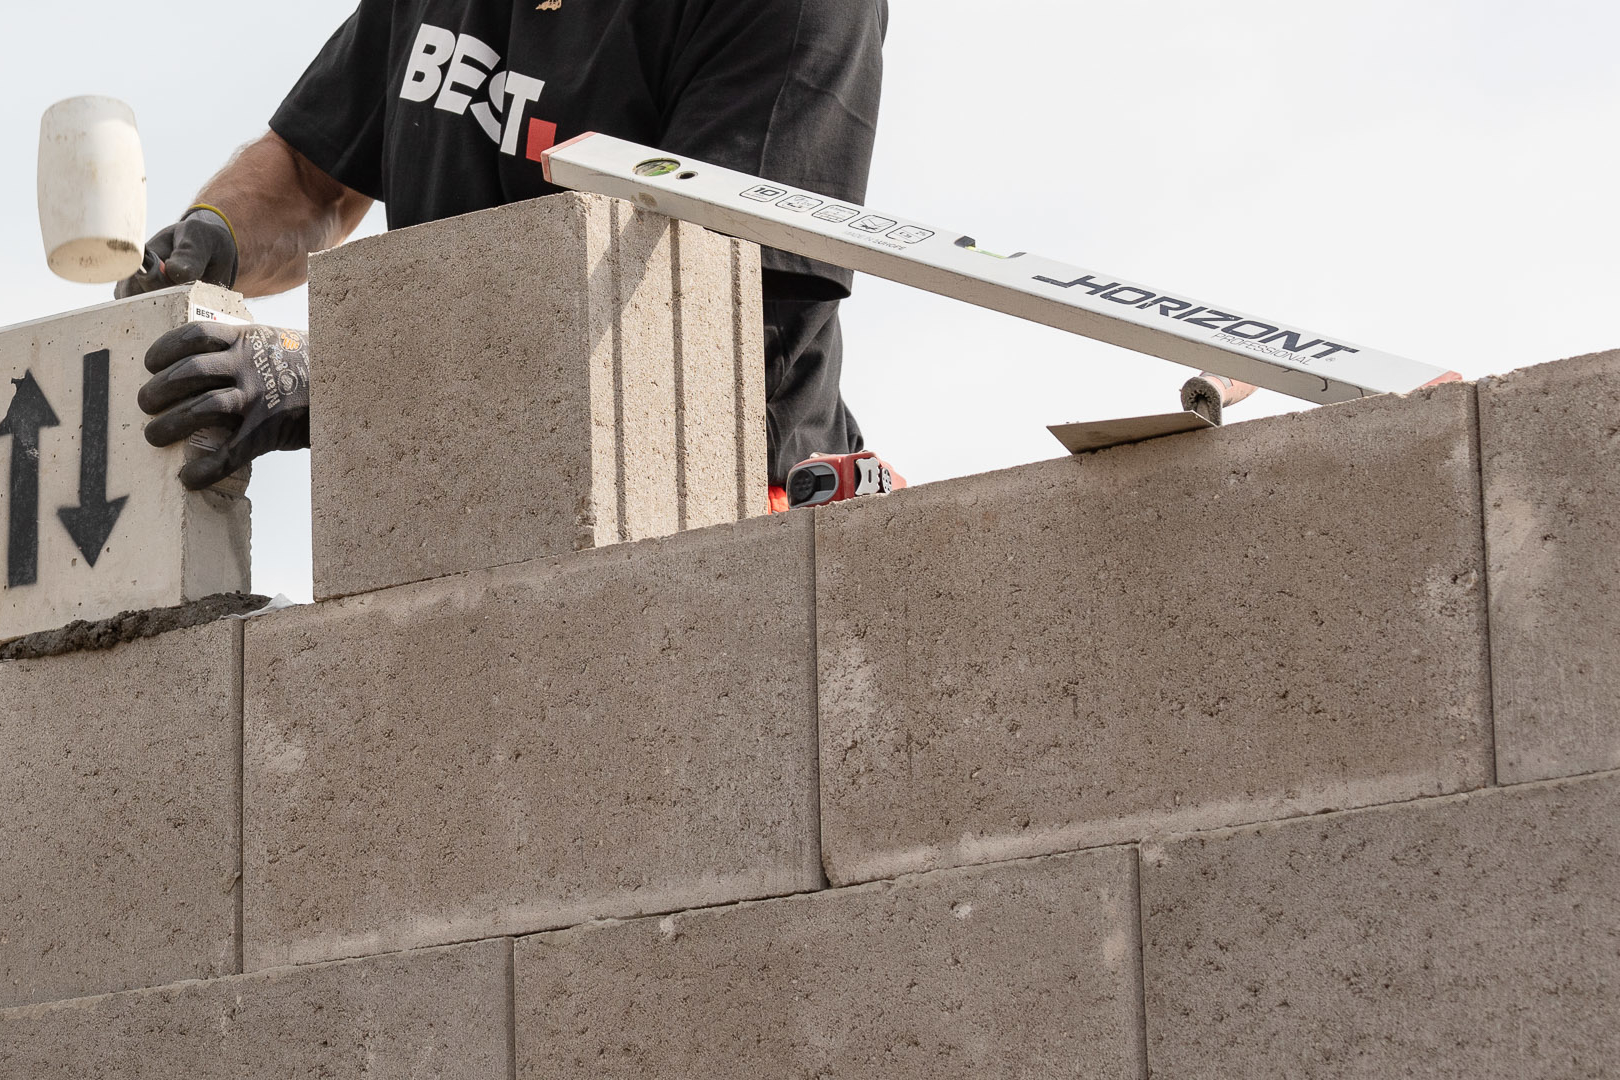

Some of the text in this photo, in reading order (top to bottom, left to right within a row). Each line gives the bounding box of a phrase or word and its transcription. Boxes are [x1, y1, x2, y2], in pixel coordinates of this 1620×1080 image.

[1032, 274, 1360, 360] HORIZONT
[1211, 332, 1312, 365] PROFESSIONAL
[249, 331, 281, 410] MaxiFlex
